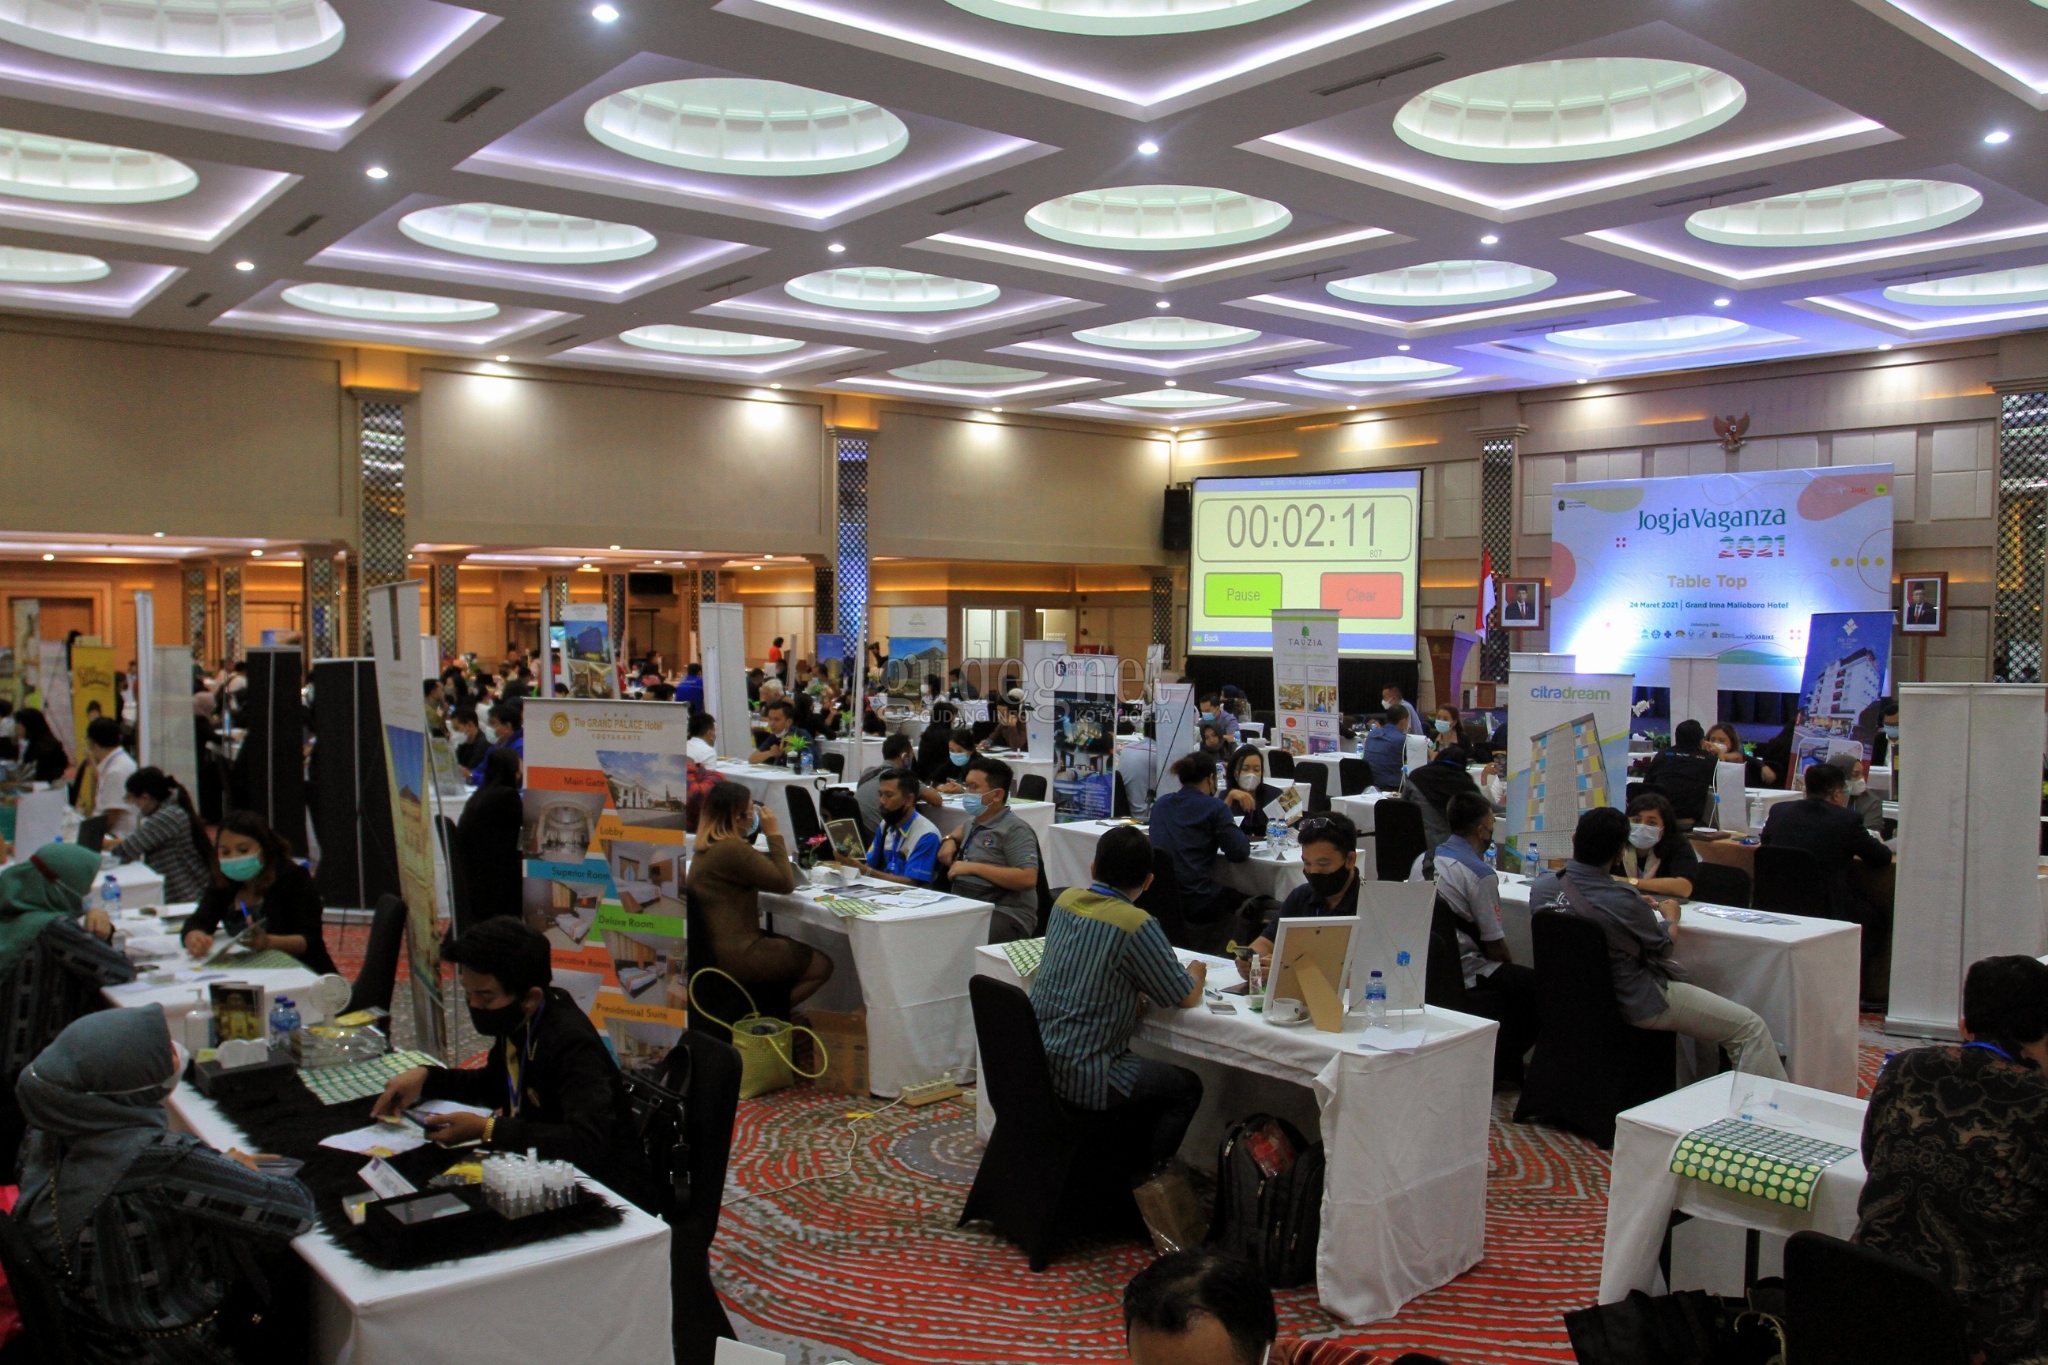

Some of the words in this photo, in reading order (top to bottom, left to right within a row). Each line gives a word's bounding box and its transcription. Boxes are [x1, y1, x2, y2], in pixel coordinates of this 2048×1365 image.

[1226, 502, 1376, 548] 00:02:11
[1718, 535, 1786, 558] 2021
[1667, 574, 1711, 588] Table
[1716, 574, 1748, 590] Top
[1227, 588, 1261, 601] Pause
[1346, 588, 1377, 602] Clear
[1204, 633, 1219, 642] Back
[1288, 638, 1323, 647] TAUZIA
[1530, 685, 1611, 700] citradream
[574, 717, 586, 727] The
[587, 718, 613, 729] GRAND
[614, 719, 643, 730] PALACE
[644, 720, 664, 731] Hotel
[1315, 719, 1330, 728] FOX
[564, 776, 584, 786] Main
[586, 777, 606, 787] Gate
[600, 826, 624, 838] Lobby
[551, 866, 585, 879] Superior
[587, 868, 611, 880] Room
[598, 915, 627, 927] Deluxe
[628, 917, 654, 929] Room
[588, 957, 611, 969] Room
[596, 1002, 645, 1018] Presidential
[646, 1005, 669, 1020] Suite
